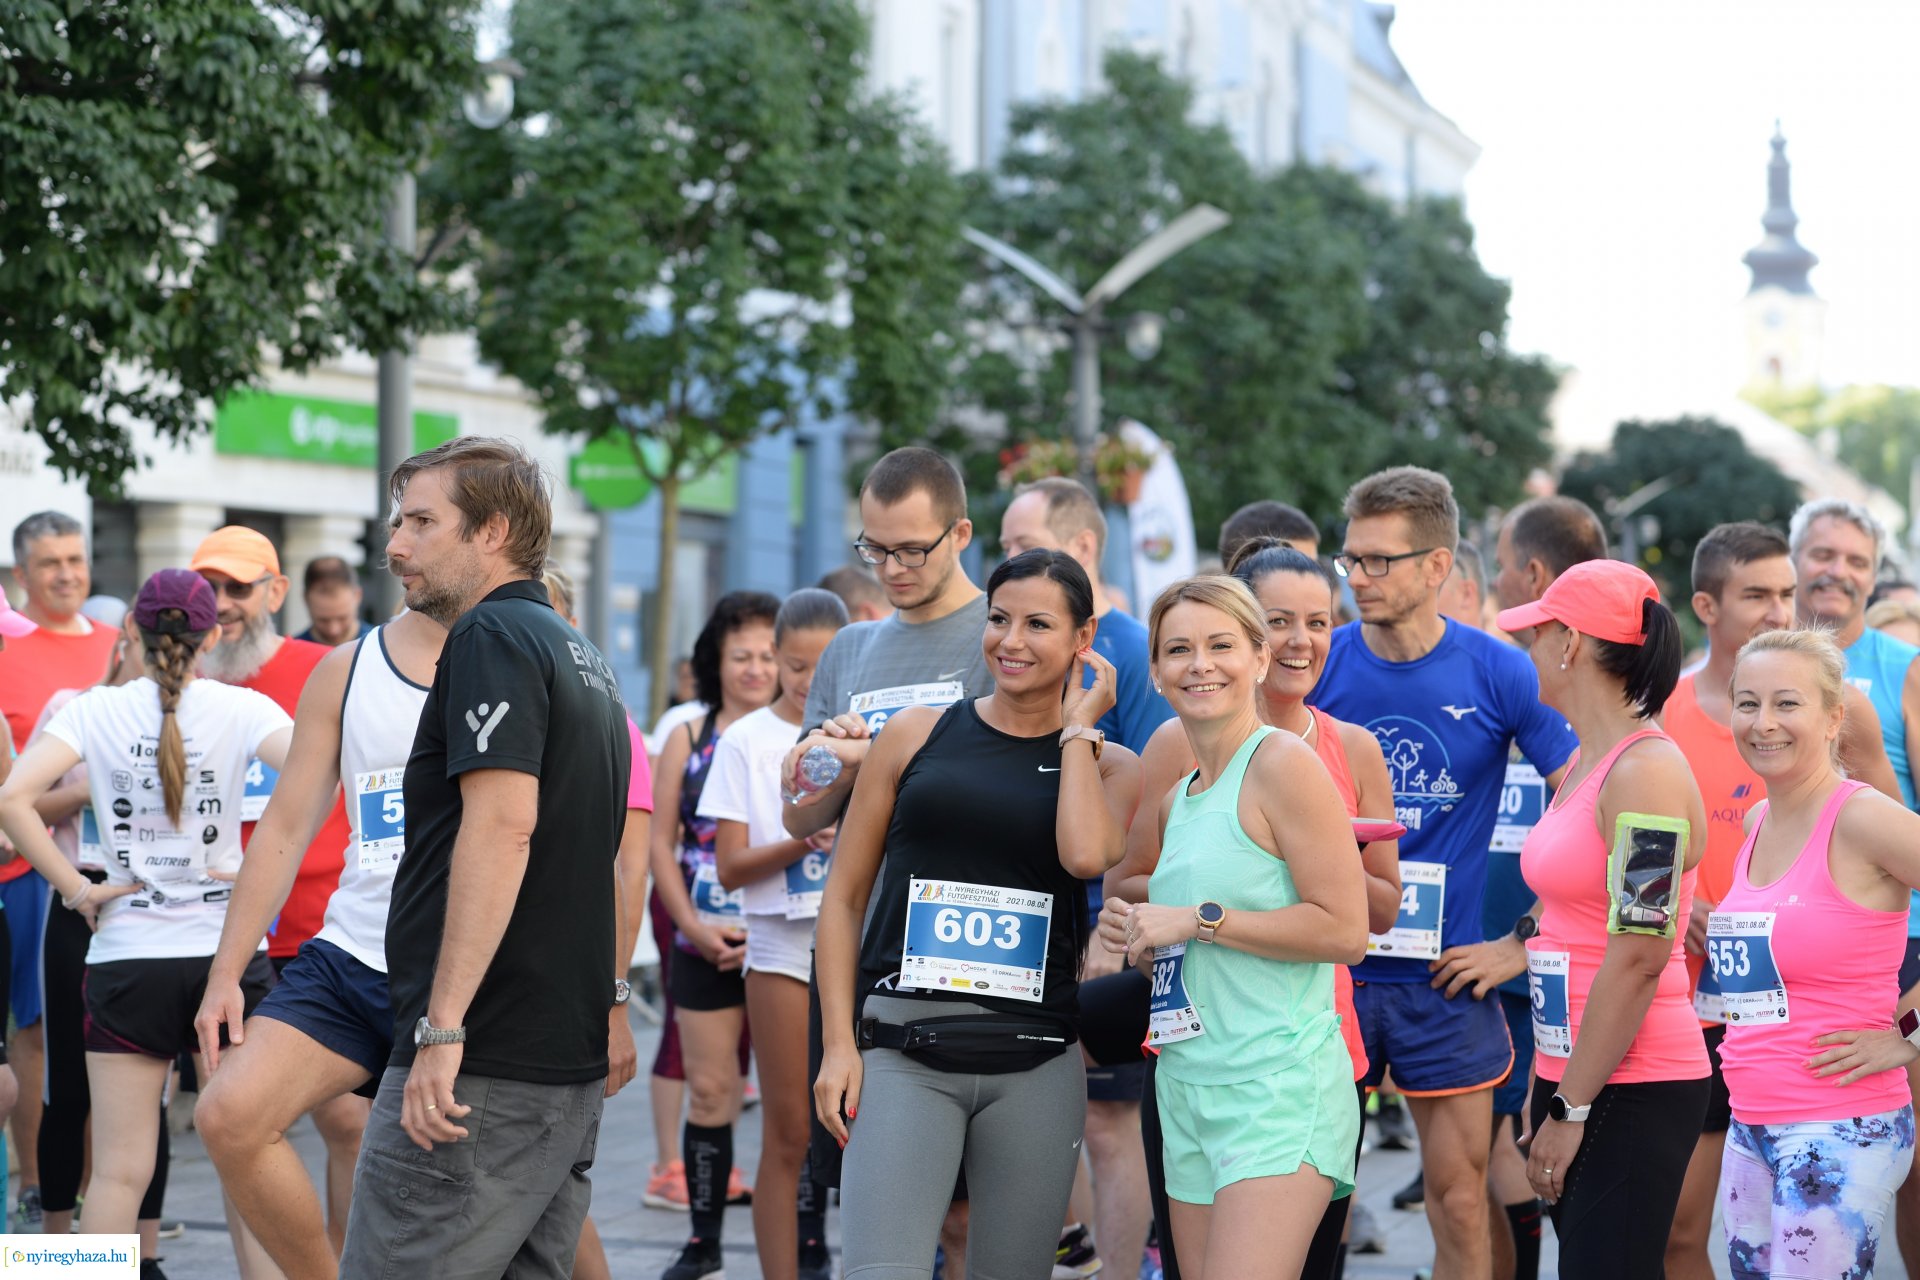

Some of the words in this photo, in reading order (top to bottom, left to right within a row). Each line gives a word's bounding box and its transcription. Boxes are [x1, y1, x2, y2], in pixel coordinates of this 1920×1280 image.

[954, 886, 1000, 896] NYÍREGYHÁZI
[1006, 896, 1047, 909] 2021.08.08.
[934, 907, 1021, 950] 603
